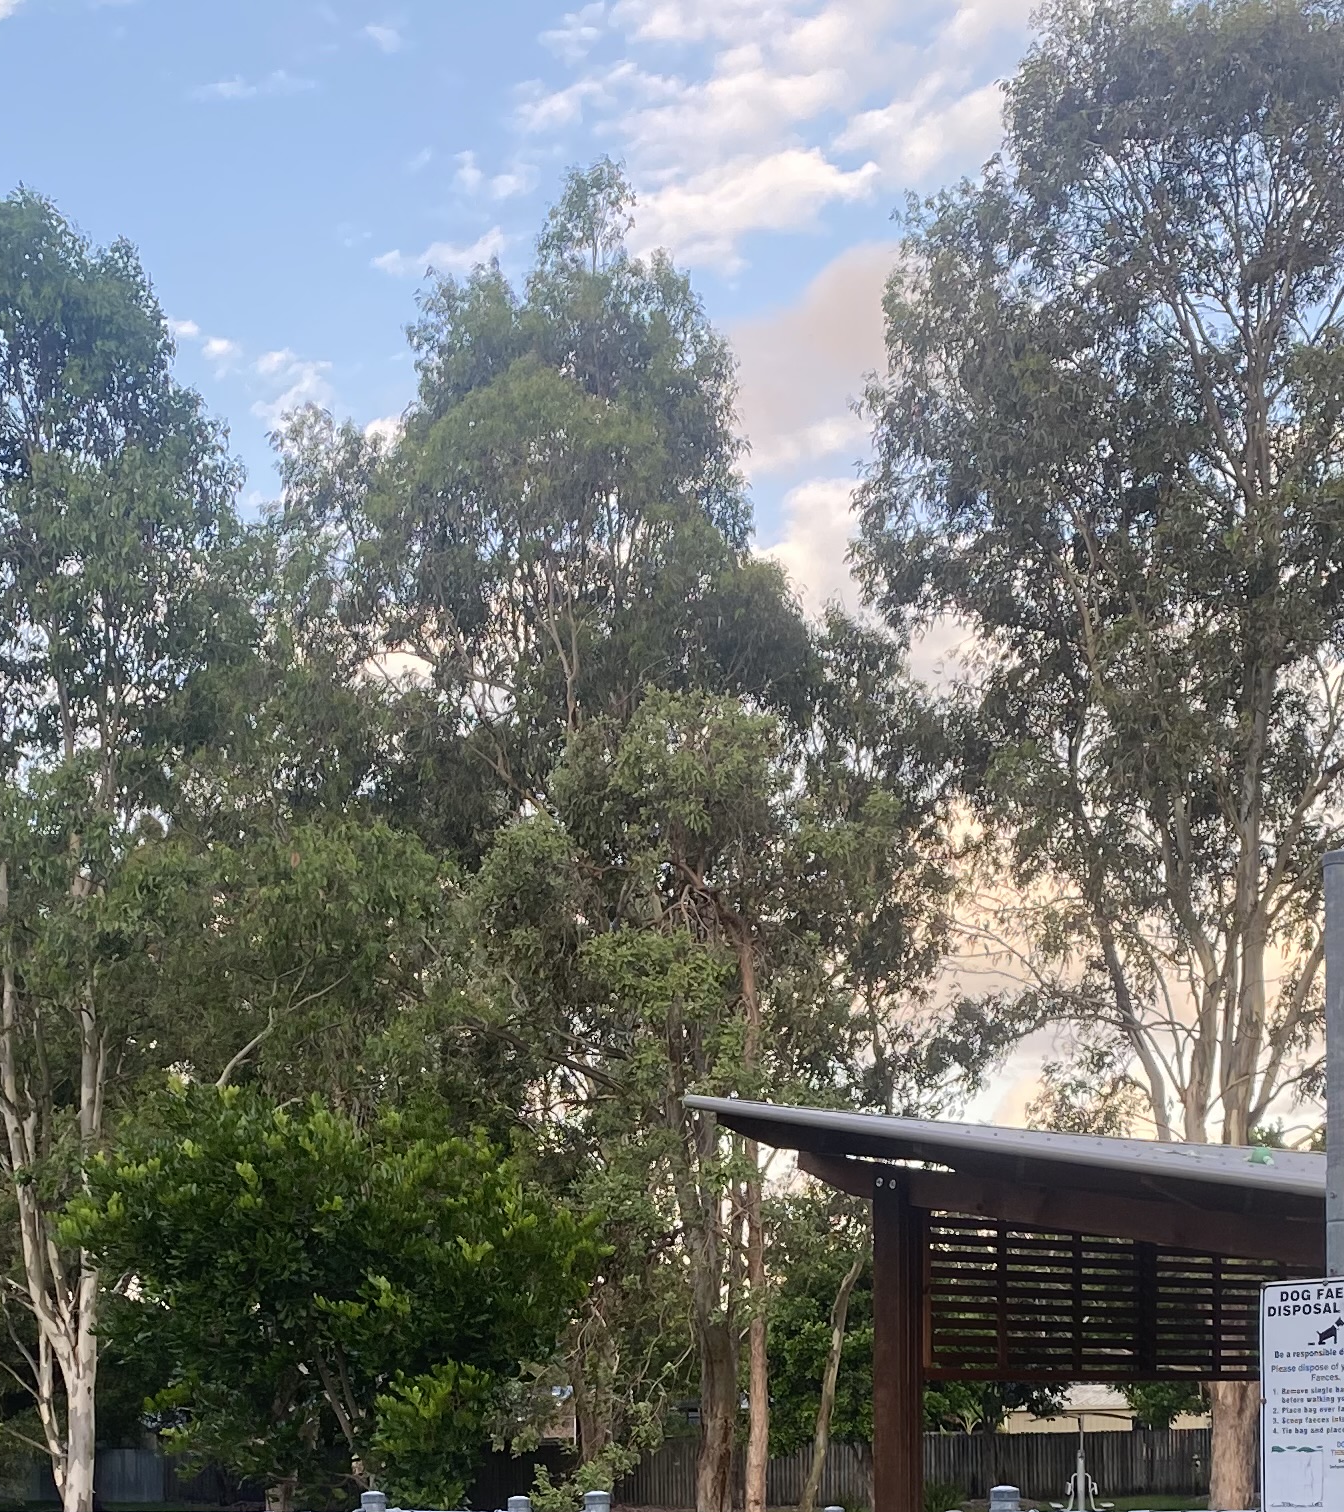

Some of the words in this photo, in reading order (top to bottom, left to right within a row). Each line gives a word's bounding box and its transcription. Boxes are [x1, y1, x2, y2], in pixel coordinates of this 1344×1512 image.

[1281, 1290, 1311, 1302] DOG
[1268, 1302, 1340, 1317] DISPOSAL
[1293, 1349, 1336, 1359] responsible
[1298, 1364, 1328, 1372] dispose
[1295, 1427, 1307, 1435] bag
